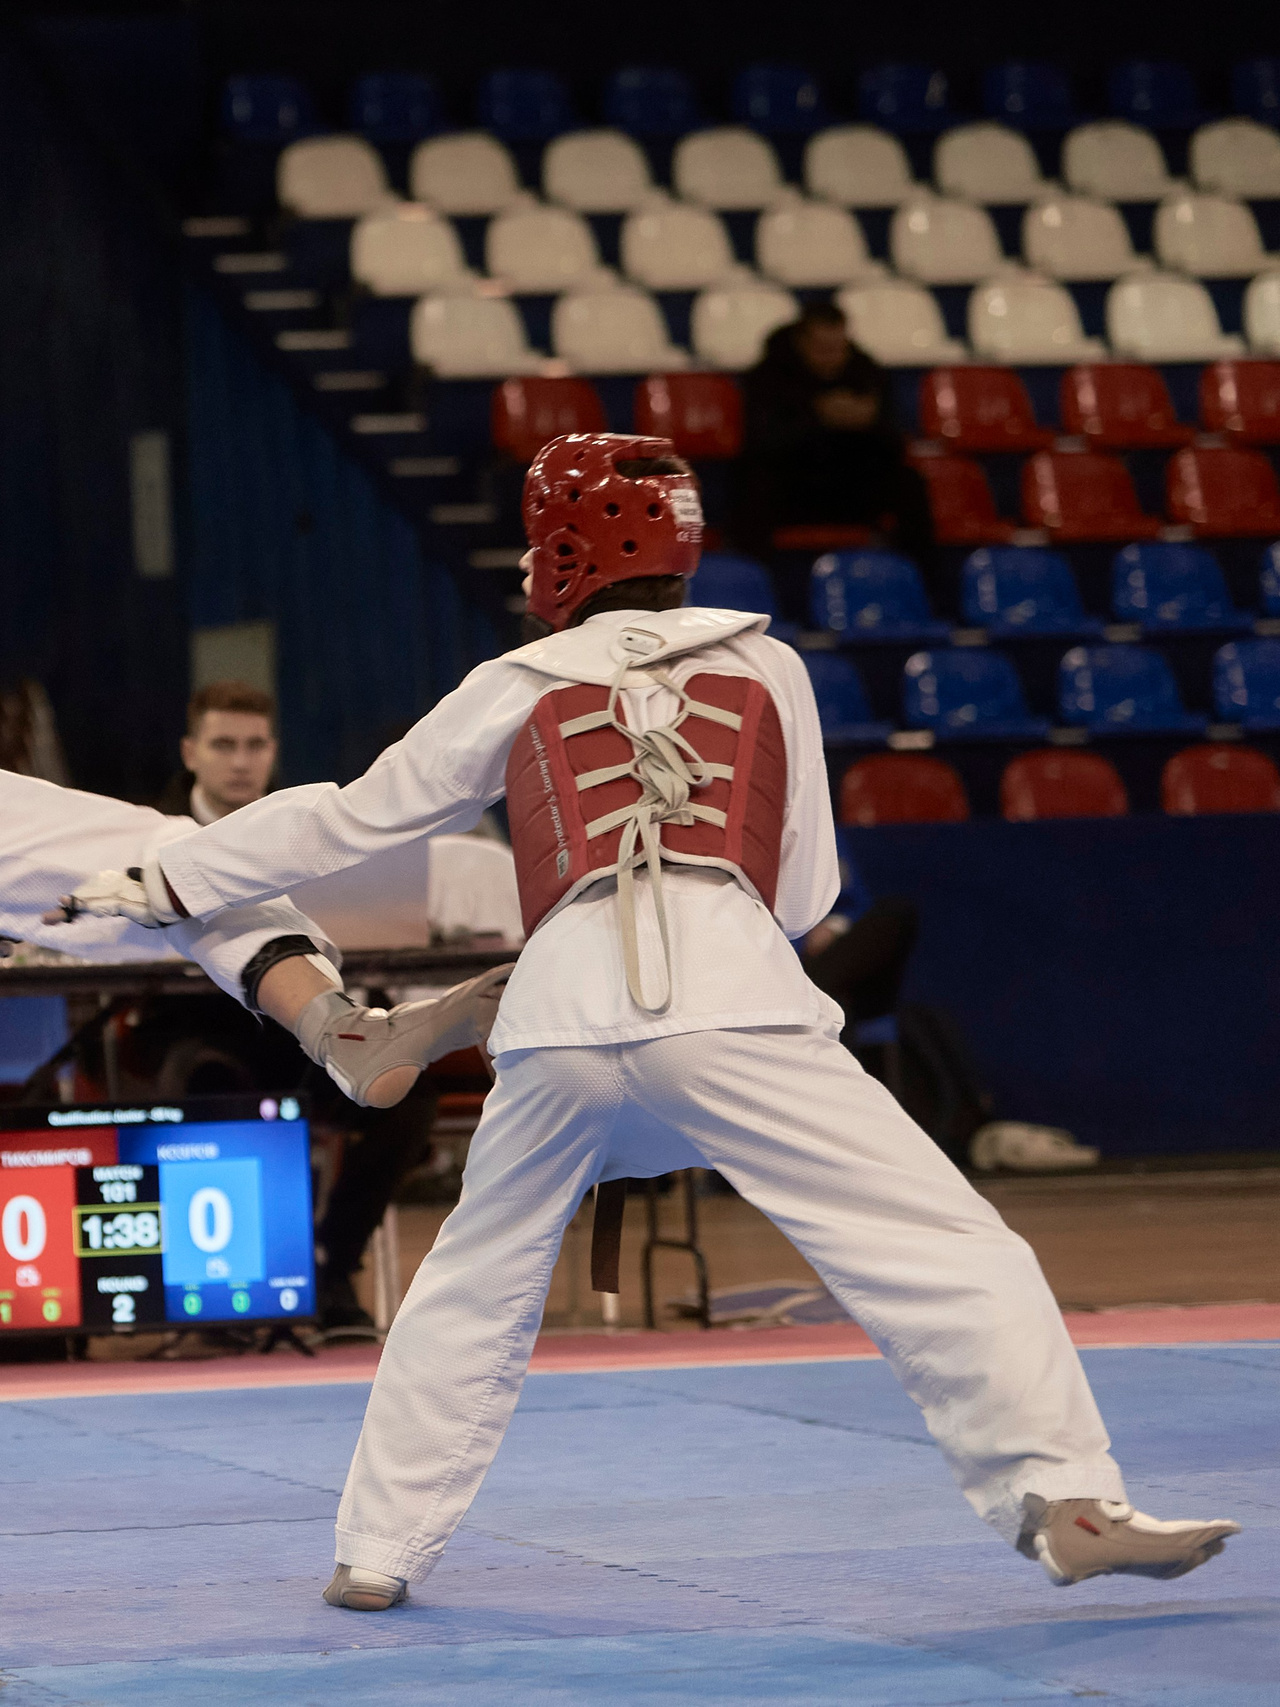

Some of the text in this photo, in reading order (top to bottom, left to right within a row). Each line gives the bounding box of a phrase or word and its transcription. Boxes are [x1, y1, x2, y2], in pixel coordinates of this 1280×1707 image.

[538, 759, 553, 794] Scoring
[550, 803, 567, 849] Protector
[48, 1110, 113, 1127] Qualification
[93, 1164, 144, 1182] MATCH
[100, 1181, 137, 1203] 101
[1, 1195, 47, 1261] 0
[82, 1212, 160, 1250] 1:38
[188, 1187, 233, 1253] 0
[97, 1275, 149, 1293] ROUND
[112, 1294, 136, 1323] 2
[279, 1288, 299, 1311] 0
